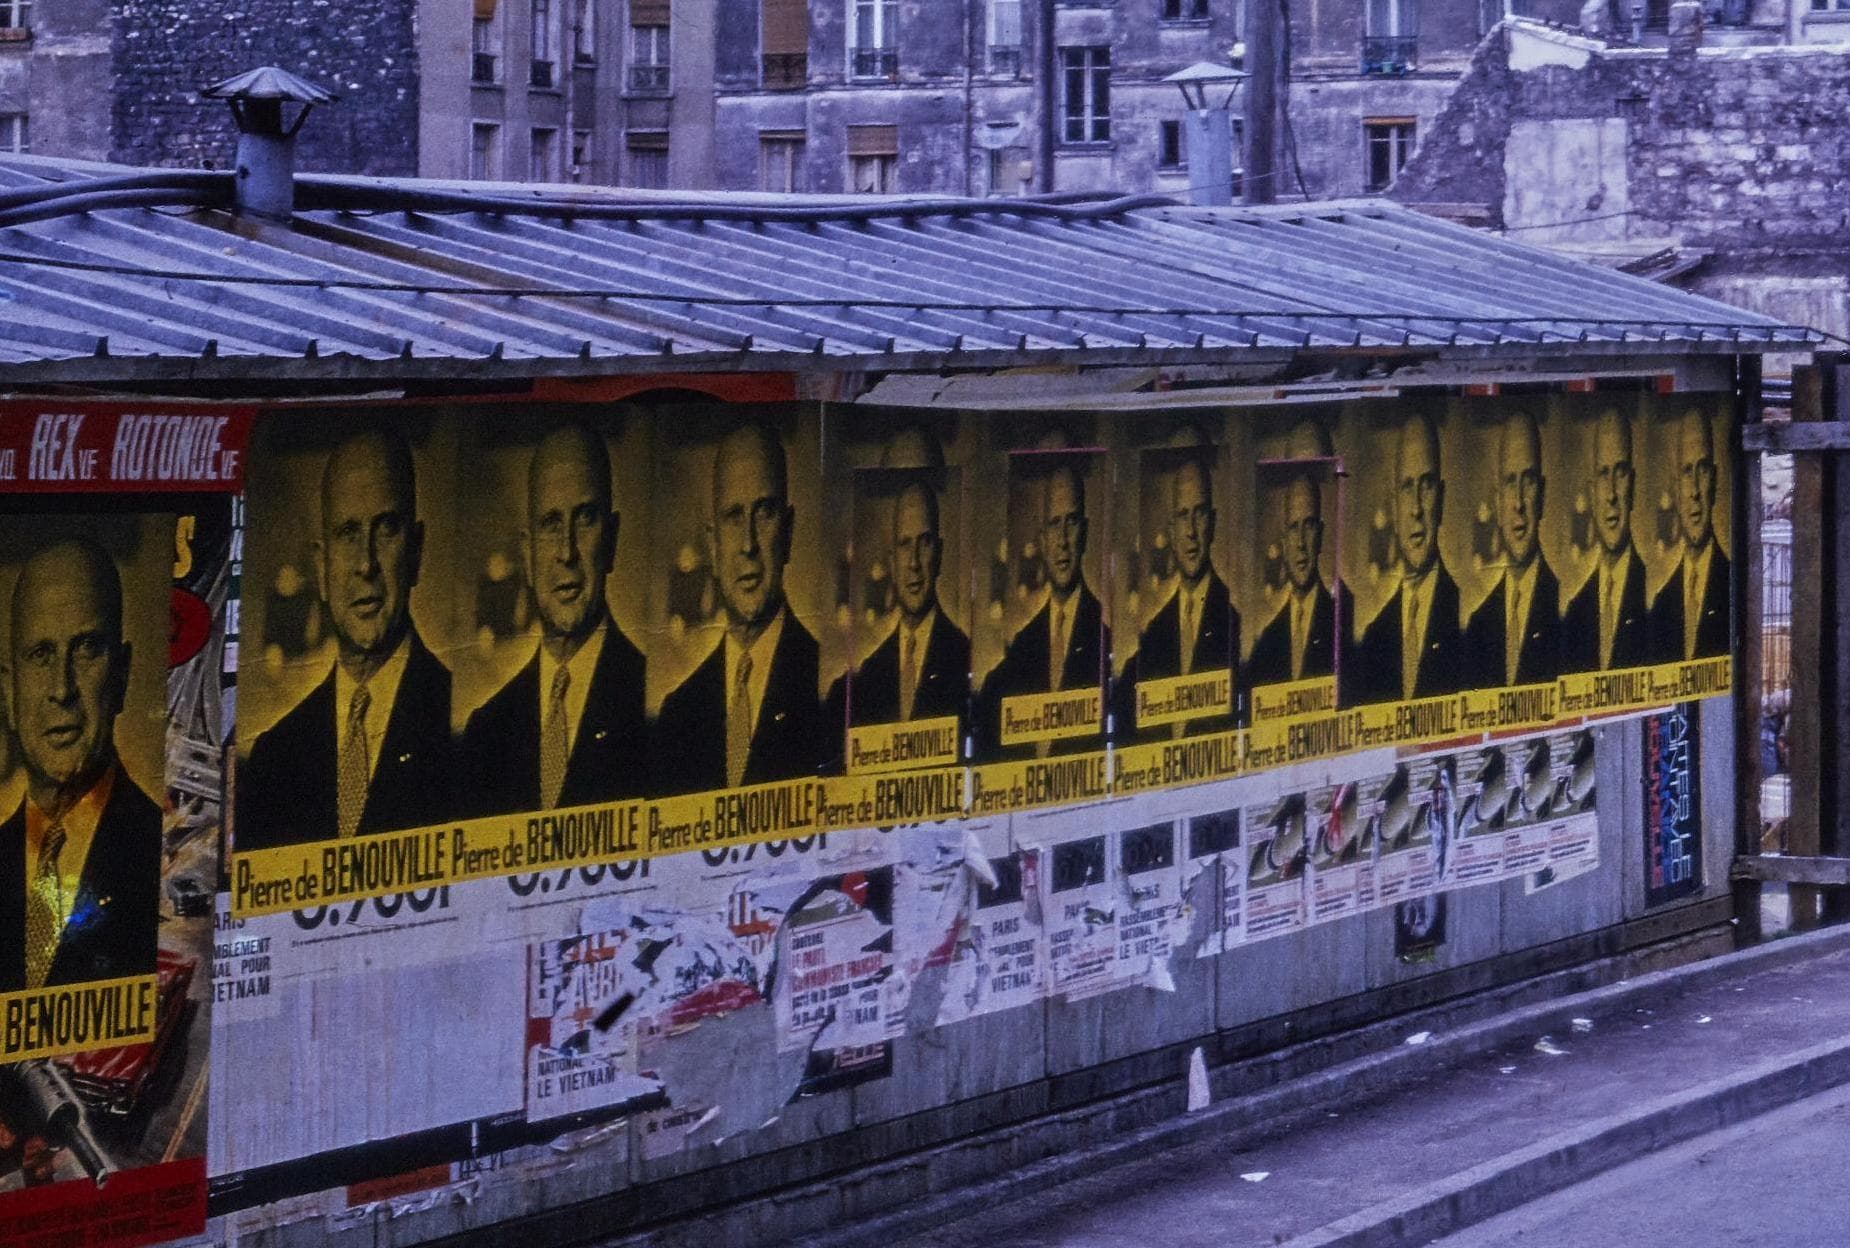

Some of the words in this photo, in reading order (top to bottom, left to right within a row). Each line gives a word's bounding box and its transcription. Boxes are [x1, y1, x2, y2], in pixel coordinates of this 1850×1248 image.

[28, 413, 86, 480] REX
[110, 414, 229, 481] ROTONDE
[1174, 679, 1228, 712] BENOUVILLE
[1286, 684, 1333, 715] BENOUVILLE
[1498, 687, 1556, 726] BENOUVILLE
[1593, 671, 1646, 707] BENOUVILLE
[1042, 697, 1099, 730] BENOUVILLE
[1395, 700, 1457, 740] BENOUVILLE
[851, 737, 878, 767] Pierre
[879, 739, 892, 763] de
[893, 726, 955, 762] BENOUVILLE
[1288, 714, 1353, 761] BENOUVILLE
[972, 771, 1007, 812] Pierre
[1009, 774, 1023, 808] de
[1025, 756, 1106, 805] BENOUVILLE
[1113, 753, 1145, 794] Pierre
[1147, 754, 1161, 787] de
[1162, 735, 1238, 783] BENOUVILLE
[648, 806, 690, 852] Pierre
[692, 806, 711, 843] de
[714, 783, 814, 840] BENOUVILLE
[815, 784, 854, 827] Pierre
[857, 788, 873, 822] de
[875, 772, 963, 821] BENOUVILLE
[451, 827, 499, 876] Pierre
[501, 827, 523, 869] de
[526, 805, 639, 865] BENOUVILLE
[236, 858, 292, 911] Pierre
[294, 858, 318, 902] de
[322, 831, 446, 897] BENOUVILLE
[241, 955, 271, 974] POUR
[5, 981, 152, 1054] BENOUVILLE
[537, 1078, 551, 1098] LE
[559, 1066, 616, 1095] VIETNAM
